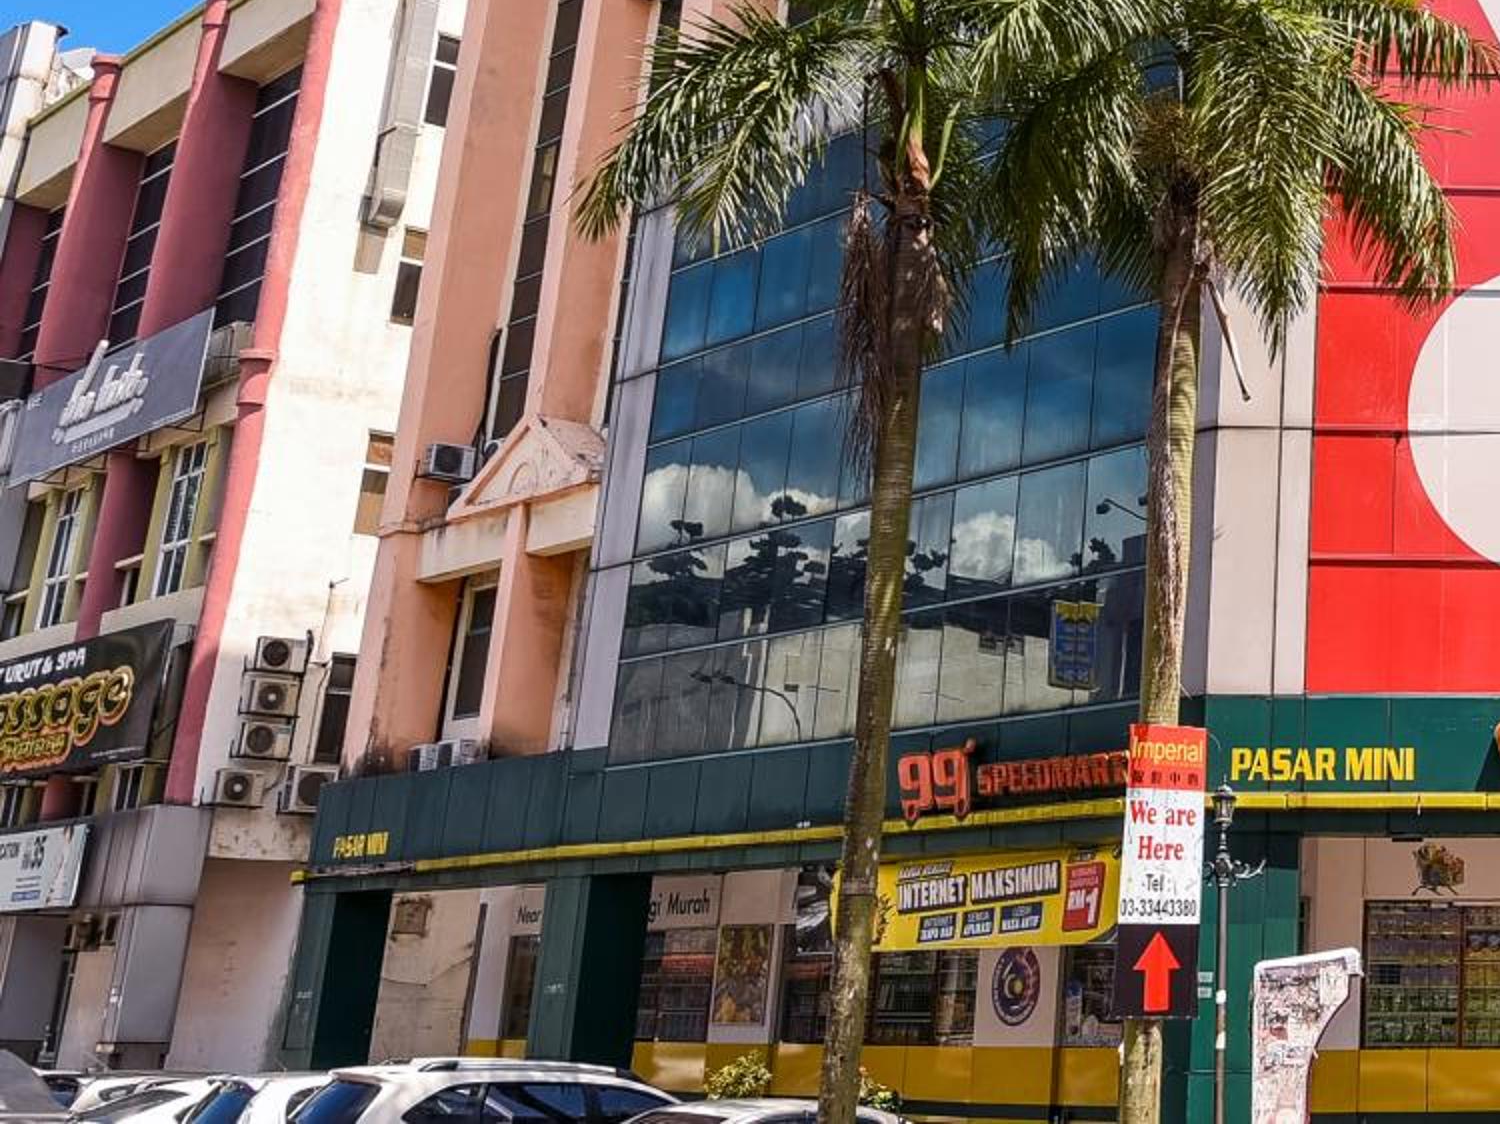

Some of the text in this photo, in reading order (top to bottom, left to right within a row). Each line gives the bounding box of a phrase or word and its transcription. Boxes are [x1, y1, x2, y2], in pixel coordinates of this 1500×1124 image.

[56, 647, 87, 672] SPA
[1131, 736, 1204, 764] Imperial
[1231, 746, 1415, 783] PASAR MINI
[898, 738, 1129, 821] 99 SPEEDMART
[1130, 799, 1197, 826] We are
[1137, 835, 1185, 861] Here
[898, 875, 967, 912] INTERNET
[970, 861, 1059, 903] MAKSIMUM
[667, 888, 710, 915] Murah
